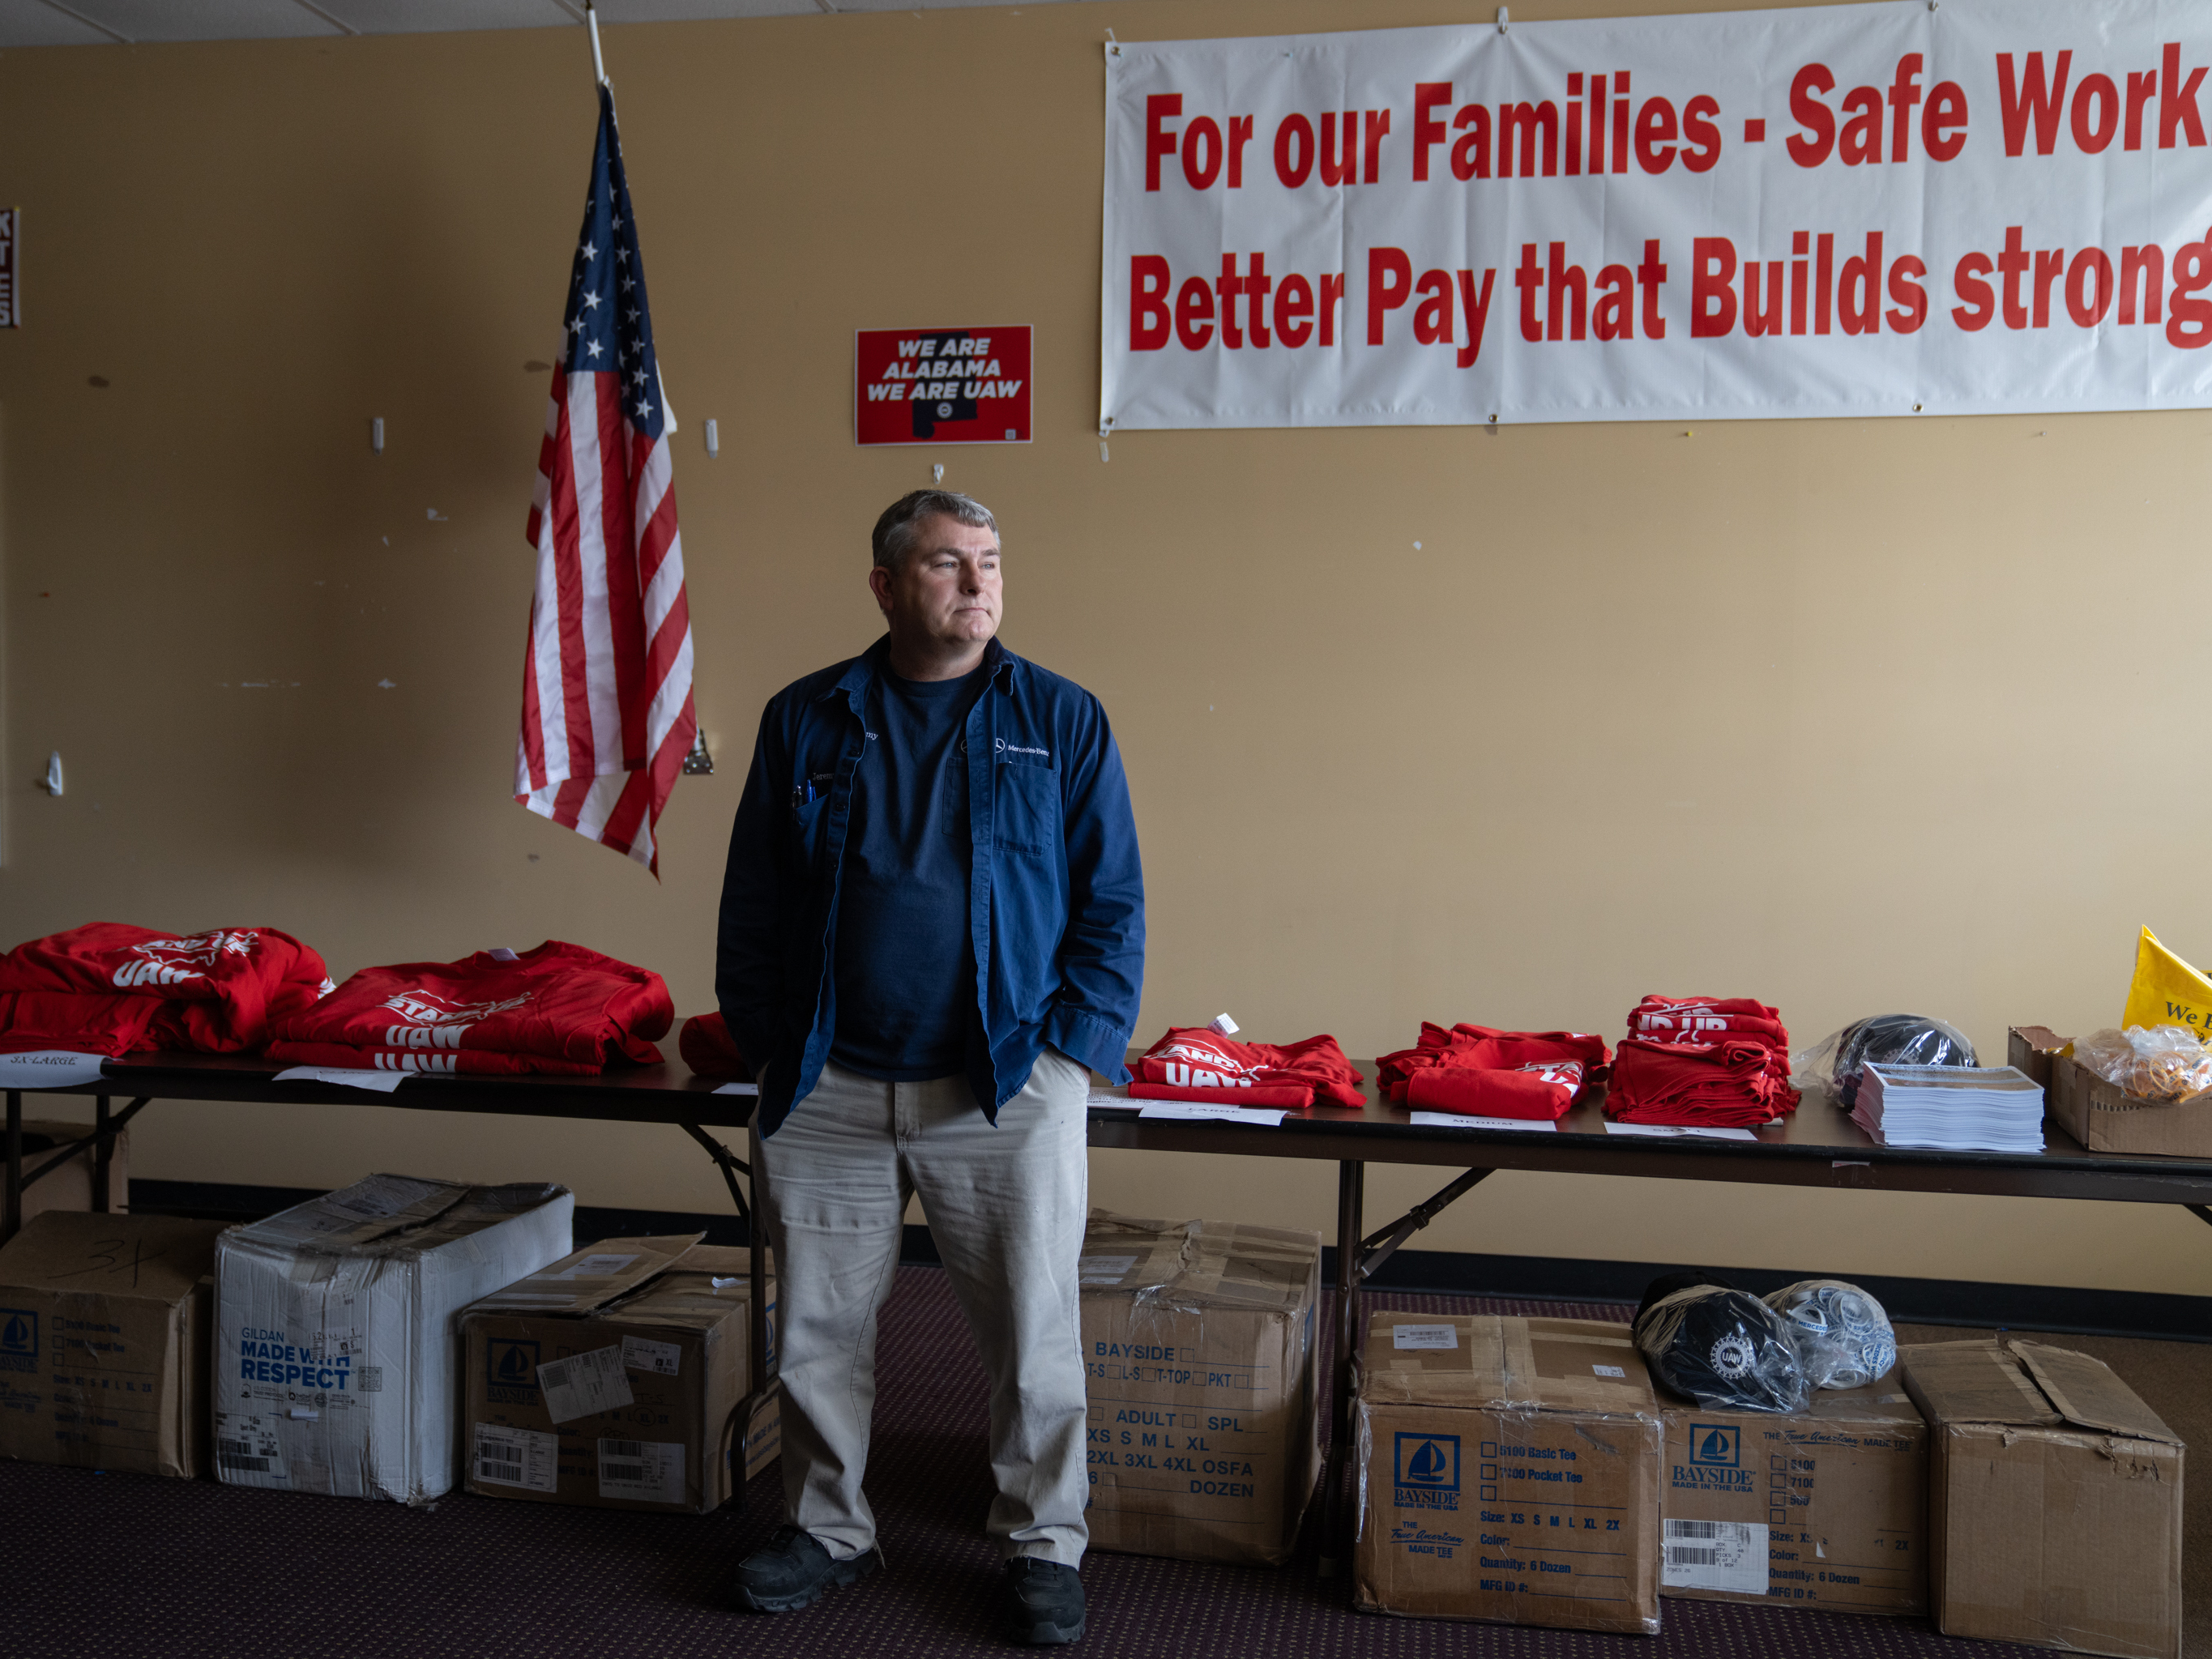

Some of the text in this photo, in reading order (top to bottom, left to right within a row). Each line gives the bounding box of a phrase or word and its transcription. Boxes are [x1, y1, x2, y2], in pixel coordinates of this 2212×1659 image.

[1145, 42, 2210, 192] For our Families - Safe Work
[1129, 225, 2212, 369] Better Pay that Builds strong
[898, 337, 991, 357] WE ARE
[882, 358, 1001, 379] ALABAMA
[867, 379, 1023, 402] WE ARE UAW
[1007, 744, 1050, 757] Mercedes-Benz
[812, 772, 835, 781] Jerem
[2165, 1000, 2198, 1025] We
[386, 1023, 476, 1050] UAW
[241, 1327, 284, 1342] GILDAN
[241, 1340, 295, 1362] MADE
[1095, 1341, 1175, 1362] BAYSIDE
[1722, 1351, 1742, 1365] UAW
[241, 1358, 350, 1390] RESPECT
[1123, 1365, 1141, 1381] L-S
[1157, 1368, 1191, 1384] T-TOP
[1208, 1372, 1232, 1388] PKT
[487, 1386, 539, 1401] BAYSIDE
[1116, 1409, 1244, 1432] ADULT SPL
[1087, 1427, 1210, 1452] XS S M L XL
[1762, 1430, 1911, 1449] THE True American MADE TEE
[1499, 1445, 1577, 1461] 5100 Basic Tee
[1086, 1450, 1253, 1477] 2XL 3XL 4XL OSFA
[1088, 1470, 1254, 1498] 6 DOZEN
[1527, 1469, 1563, 1482] Pocket
[1565, 1471, 1583, 1484] Tee
[1672, 1465, 1753, 1486] BAYSIDE
[1672, 1481, 1698, 1489] MADE
[1701, 1482, 1710, 1491] IN
[1713, 1483, 1732, 1491] THE
[1394, 1488, 1458, 1505] BAYSIDE
[1402, 1520, 1418, 1529] THE
[1480, 1510, 1621, 1531] Size: XS S M L XL 2X
[1390, 1529, 1465, 1543] True American
[1480, 1533, 1510, 1546] Color:
[1769, 1530, 1794, 1542] Size:
[1895, 1539, 1909, 1550] 2X
[1408, 1544, 1453, 1555] MADE TEE
[1769, 1549, 1799, 1562] Color:
[1480, 1556, 1571, 1574] Quantity: 6 Dozen
[1769, 1567, 1860, 1585] Quantity: 6 Dozen
[1480, 1579, 1502, 1592] MFG
[1505, 1580, 1516, 1593] ID
[1768, 1586, 1791, 1597] MFG
[1793, 1588, 1804, 1599] ID
